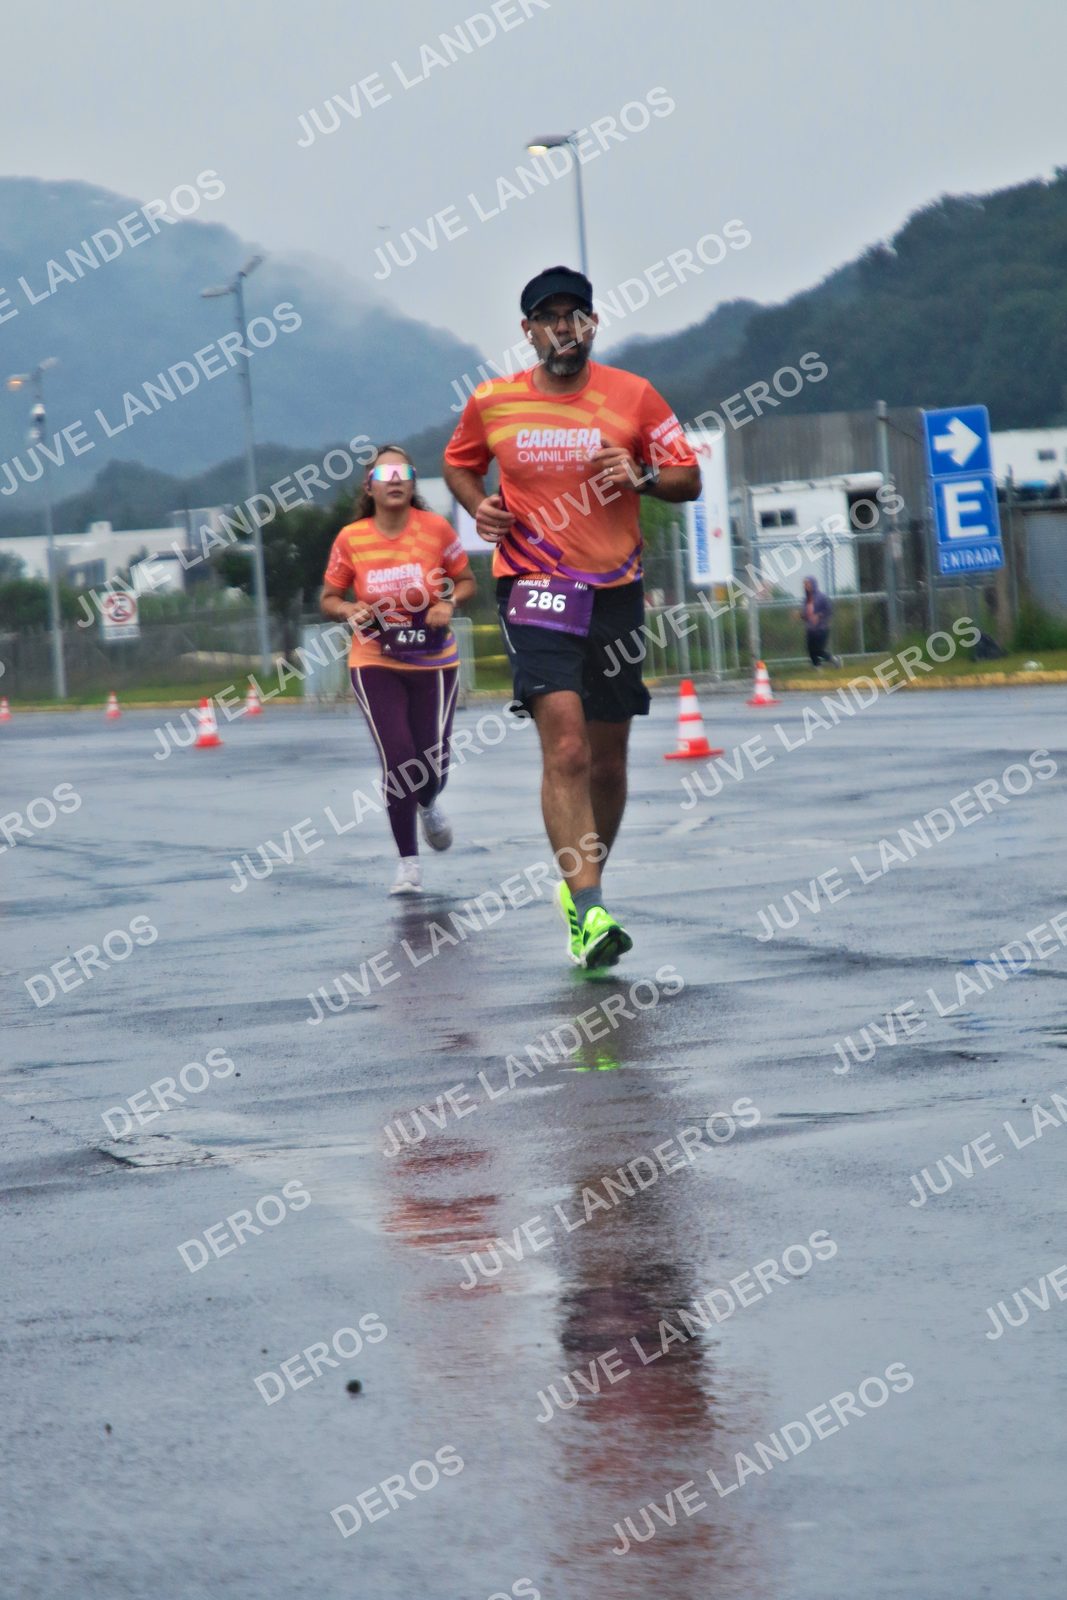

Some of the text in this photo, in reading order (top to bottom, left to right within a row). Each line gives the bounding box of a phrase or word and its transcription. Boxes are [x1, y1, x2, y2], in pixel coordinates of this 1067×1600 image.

[516, 428, 602, 448] CARRERA
[518, 450, 583, 463] OMNILIFE
[942, 480, 990, 539] E
[943, 546, 1001, 569] ENTRADA
[367, 563, 423, 583] CARRERA
[525, 590, 567, 612] 286
[397, 629, 426, 643] 476
